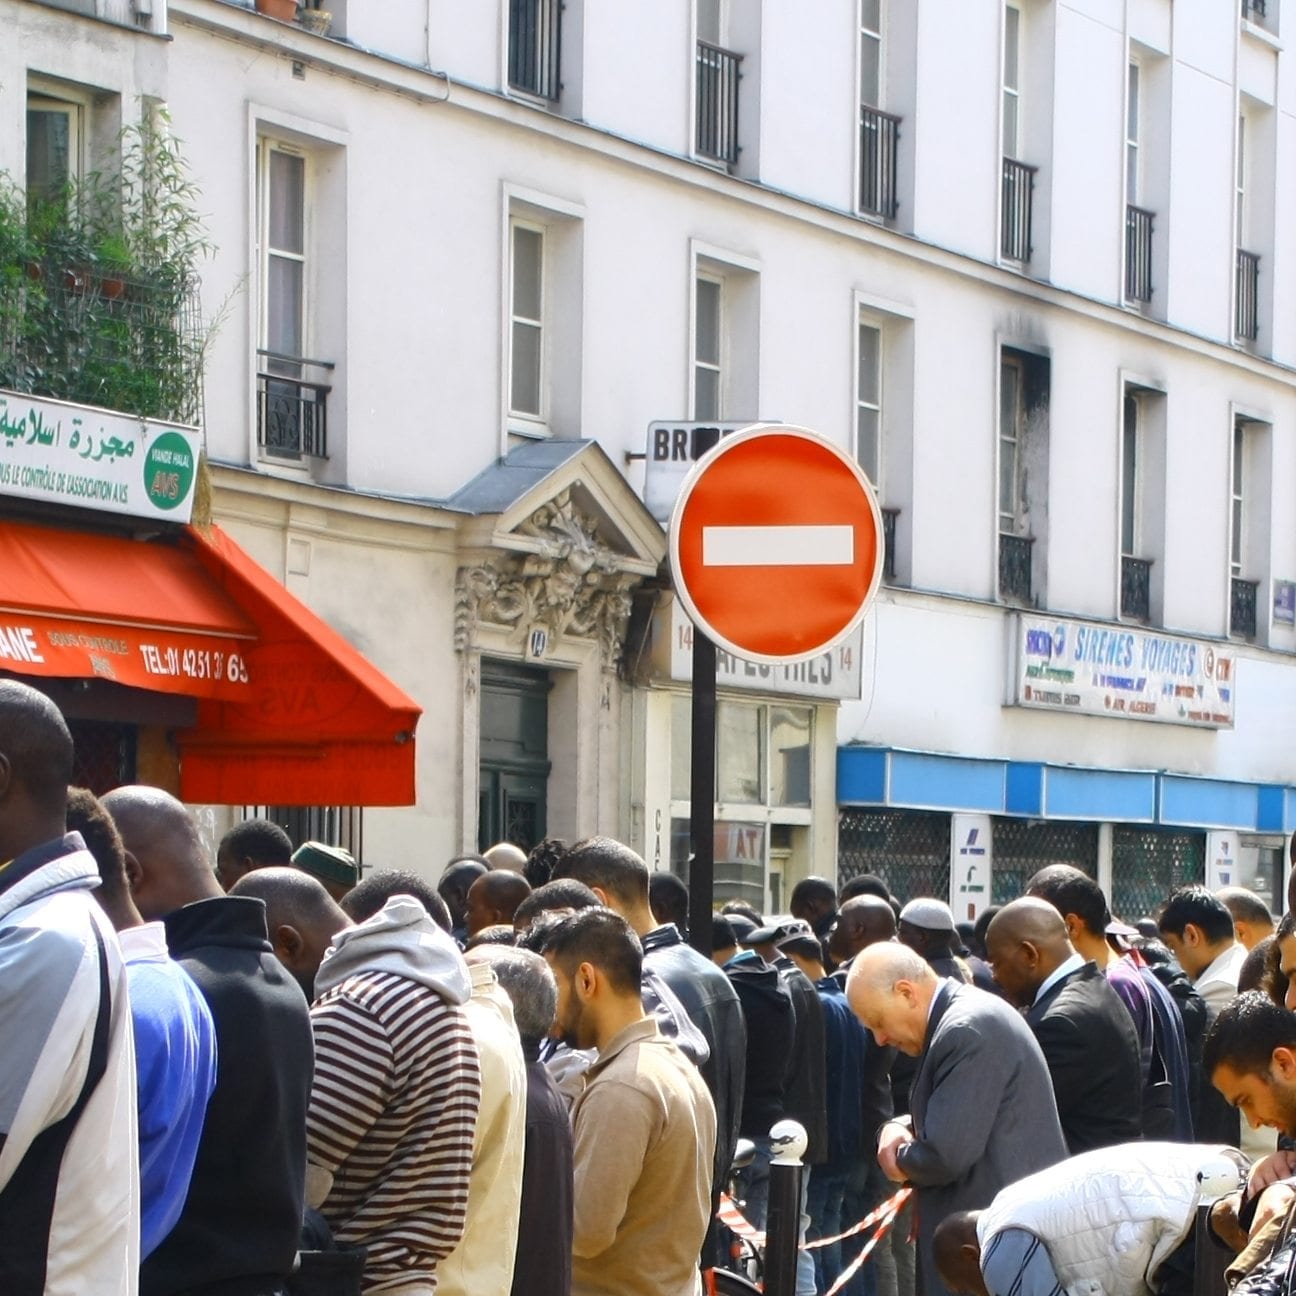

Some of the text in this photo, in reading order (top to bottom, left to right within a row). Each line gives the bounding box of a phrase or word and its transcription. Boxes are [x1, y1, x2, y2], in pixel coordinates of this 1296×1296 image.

[69, 417, 135, 465] مجزرة
[12, 464, 20, 486] LE
[56, 472, 66, 493] DE
[151, 470, 180, 500] AVS
[678, 625, 693, 651] 14
[1075, 626, 1134, 669] SIRENES
[1141, 637, 1197, 677] VOYAGES
[840, 646, 852, 671] 14
